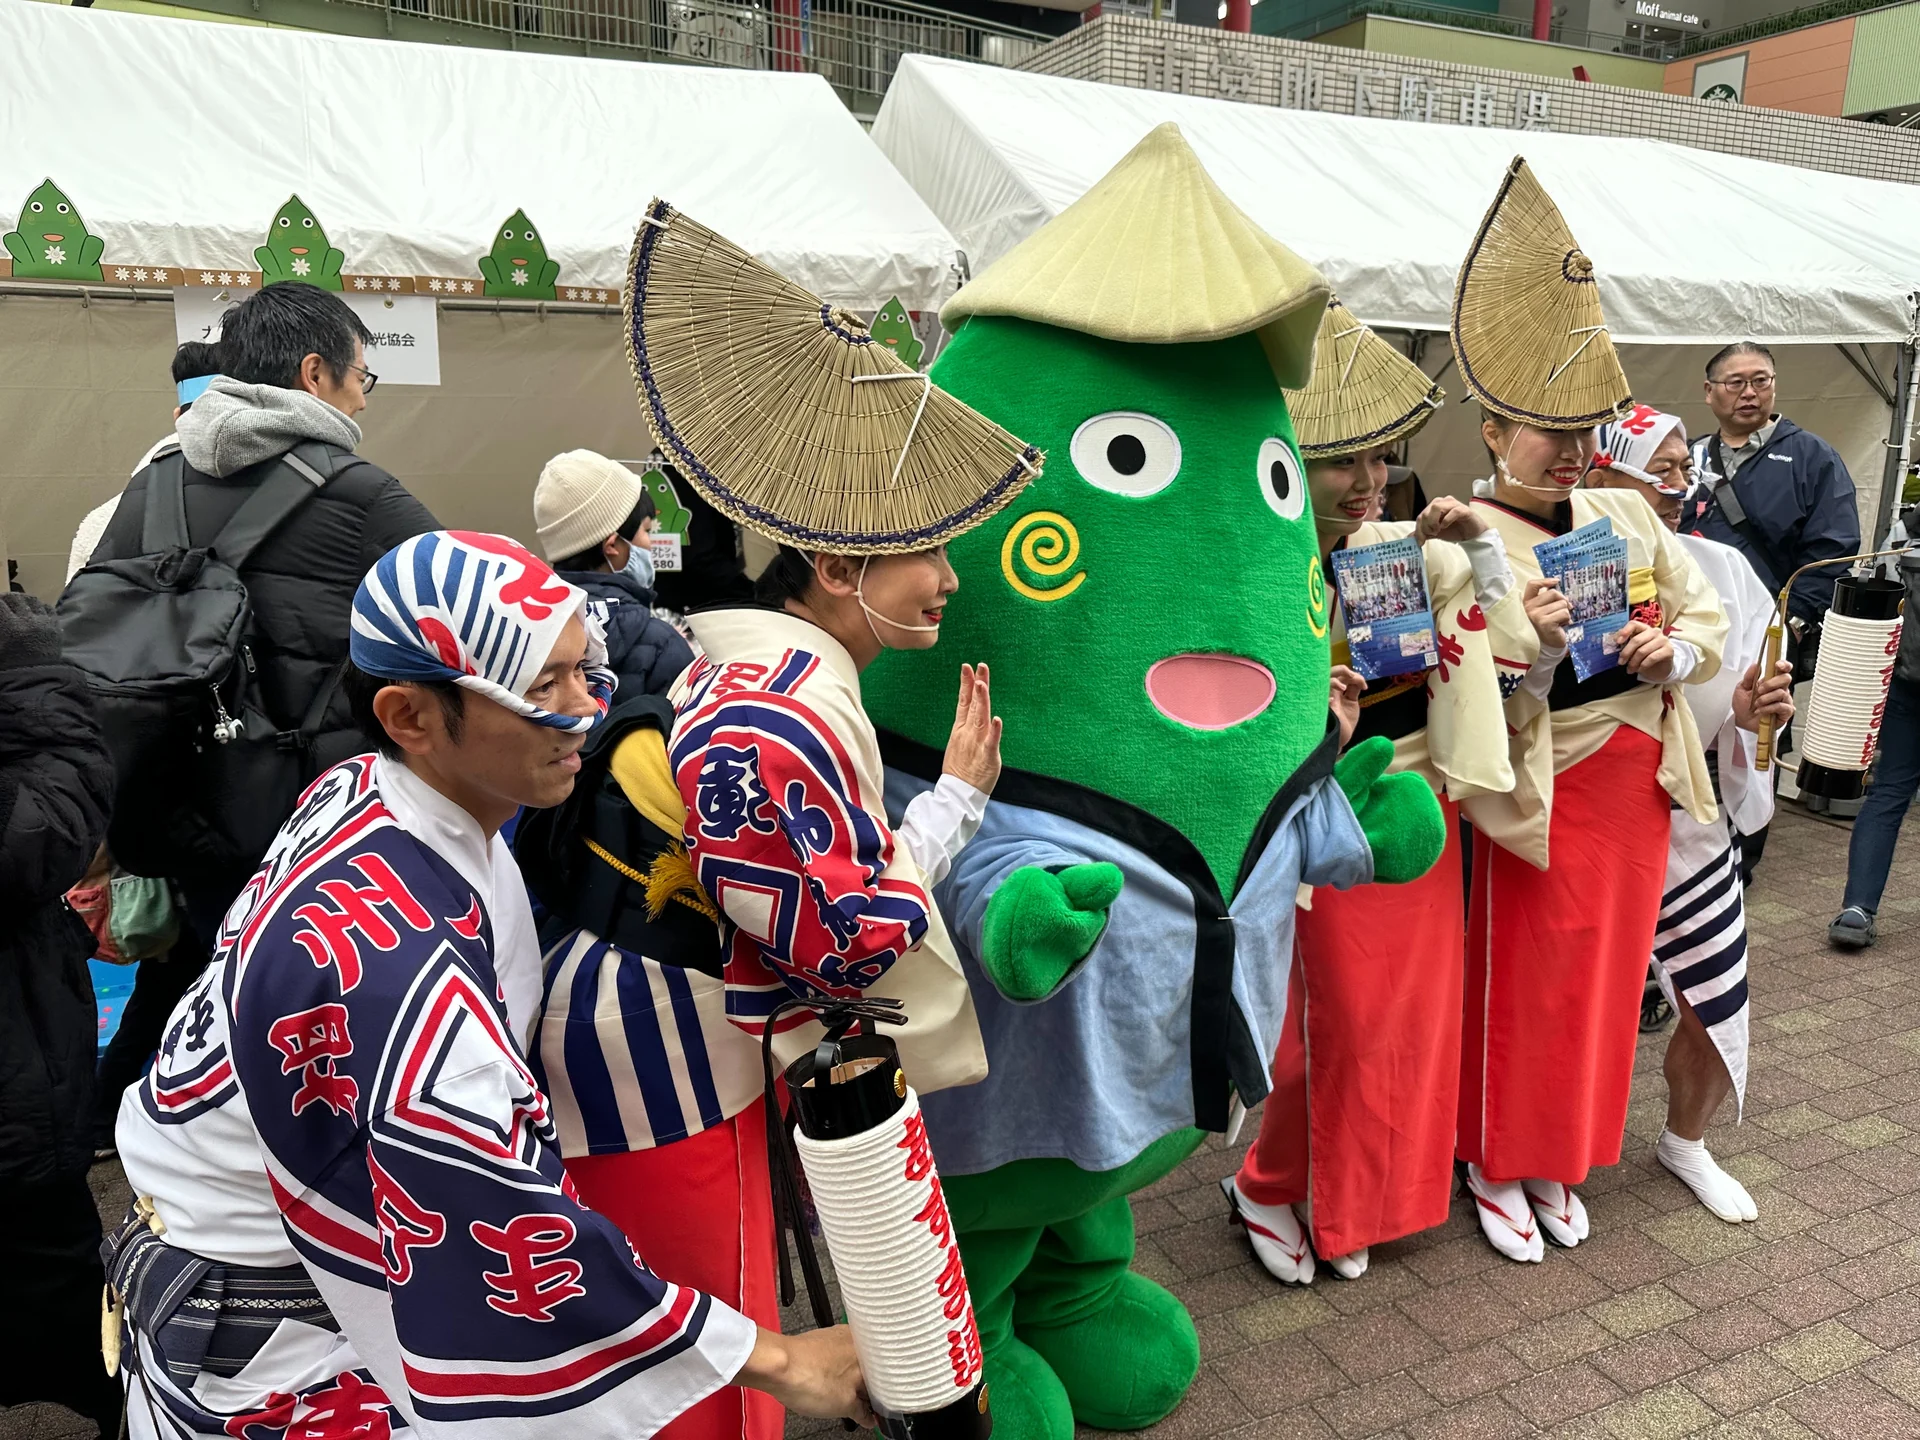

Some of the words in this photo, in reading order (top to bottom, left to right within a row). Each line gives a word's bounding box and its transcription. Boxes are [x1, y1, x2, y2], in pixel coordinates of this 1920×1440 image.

[1635, 1, 1660, 17] Moff
[1659, 10, 1682, 22] animal
[1683, 14, 1699, 25] cafe
[1141, 39, 1553, 132] 市営地下駐車場
[365, 332, 415, 348] 光協会
[653, 560, 674, 569] 580
